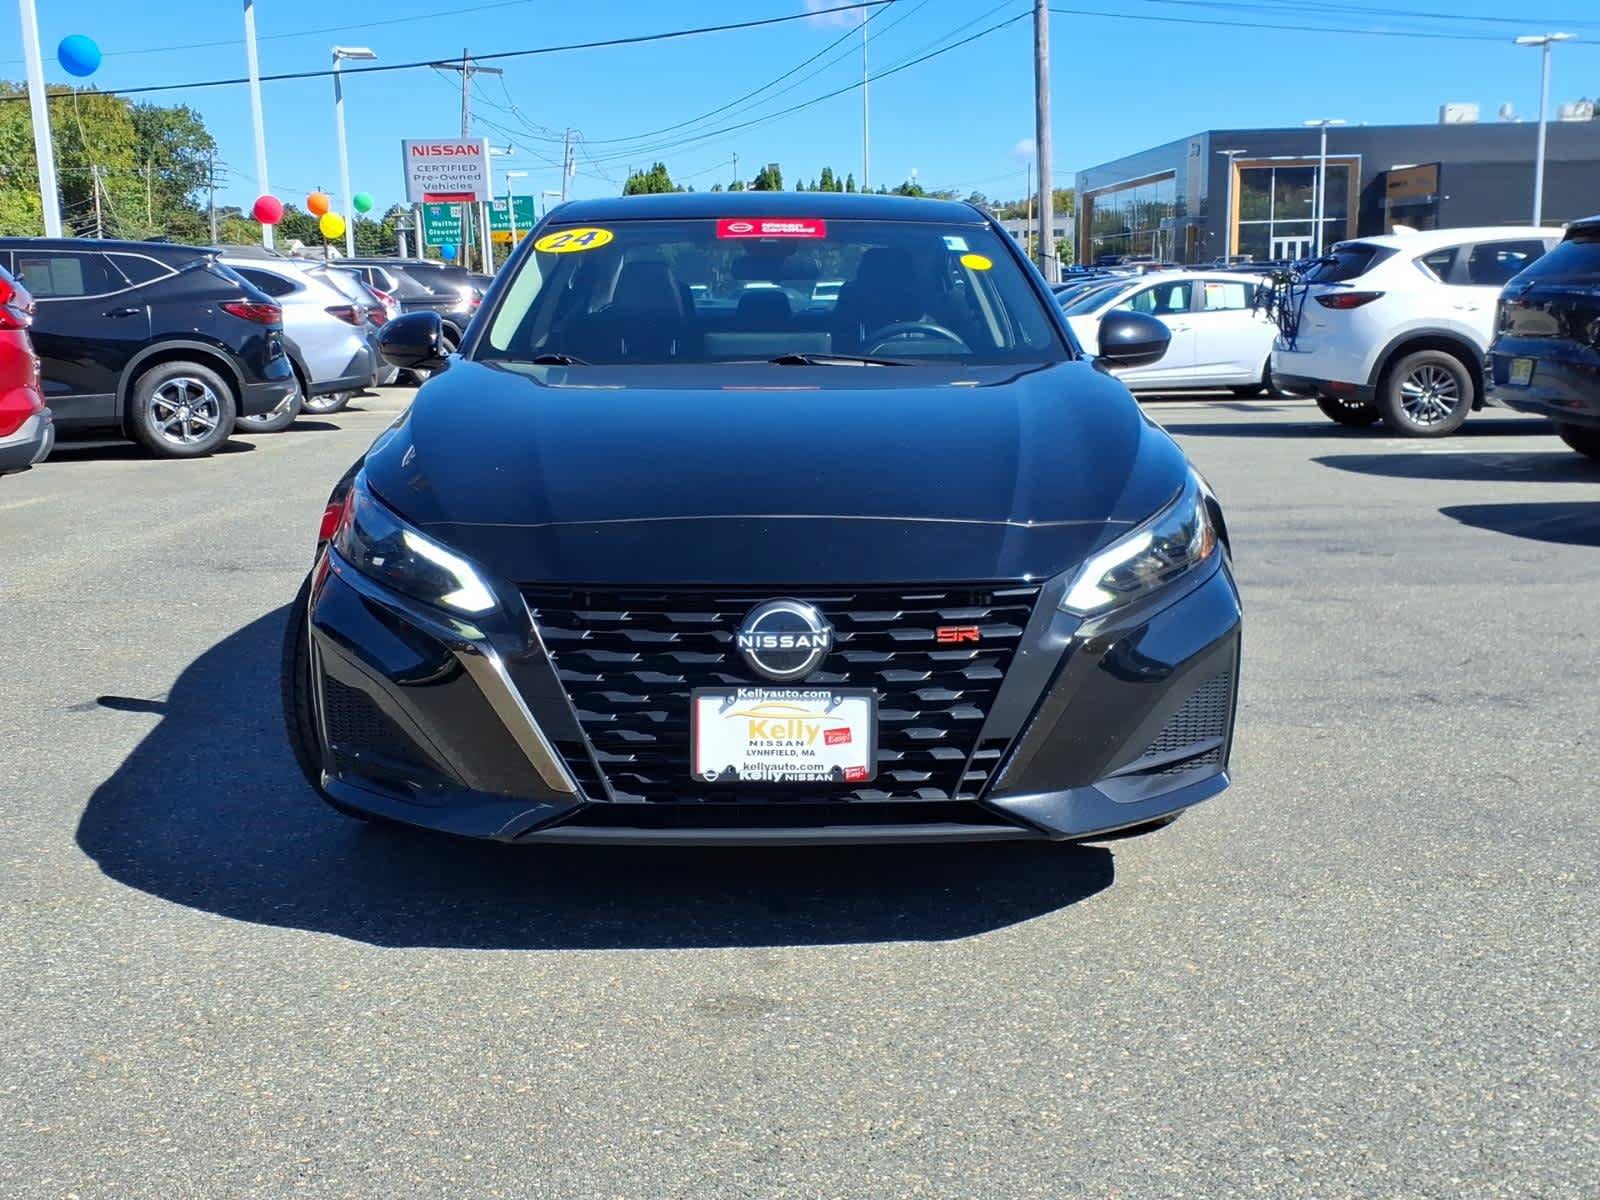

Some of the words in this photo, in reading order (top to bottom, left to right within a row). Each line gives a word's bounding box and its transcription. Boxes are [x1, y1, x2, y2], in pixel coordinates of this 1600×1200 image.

[412, 144, 480, 156] NISSAN
[416, 164, 477, 172] CERTIFIED
[414, 173, 481, 181] Pre-Owned
[423, 182, 473, 191] Vehicles
[546, 231, 599, 250] 24
[936, 625, 980, 643] SR
[738, 634, 828, 648] NISSAN
[737, 688, 832, 702] Kellyauto.com
[748, 719, 821, 746] Kelly
[746, 749, 799, 758] LYNNFIELD,
[801, 749, 816, 757] MA
[743, 761, 824, 773] kellyauto.com
[738, 770, 785, 782] Kelly
